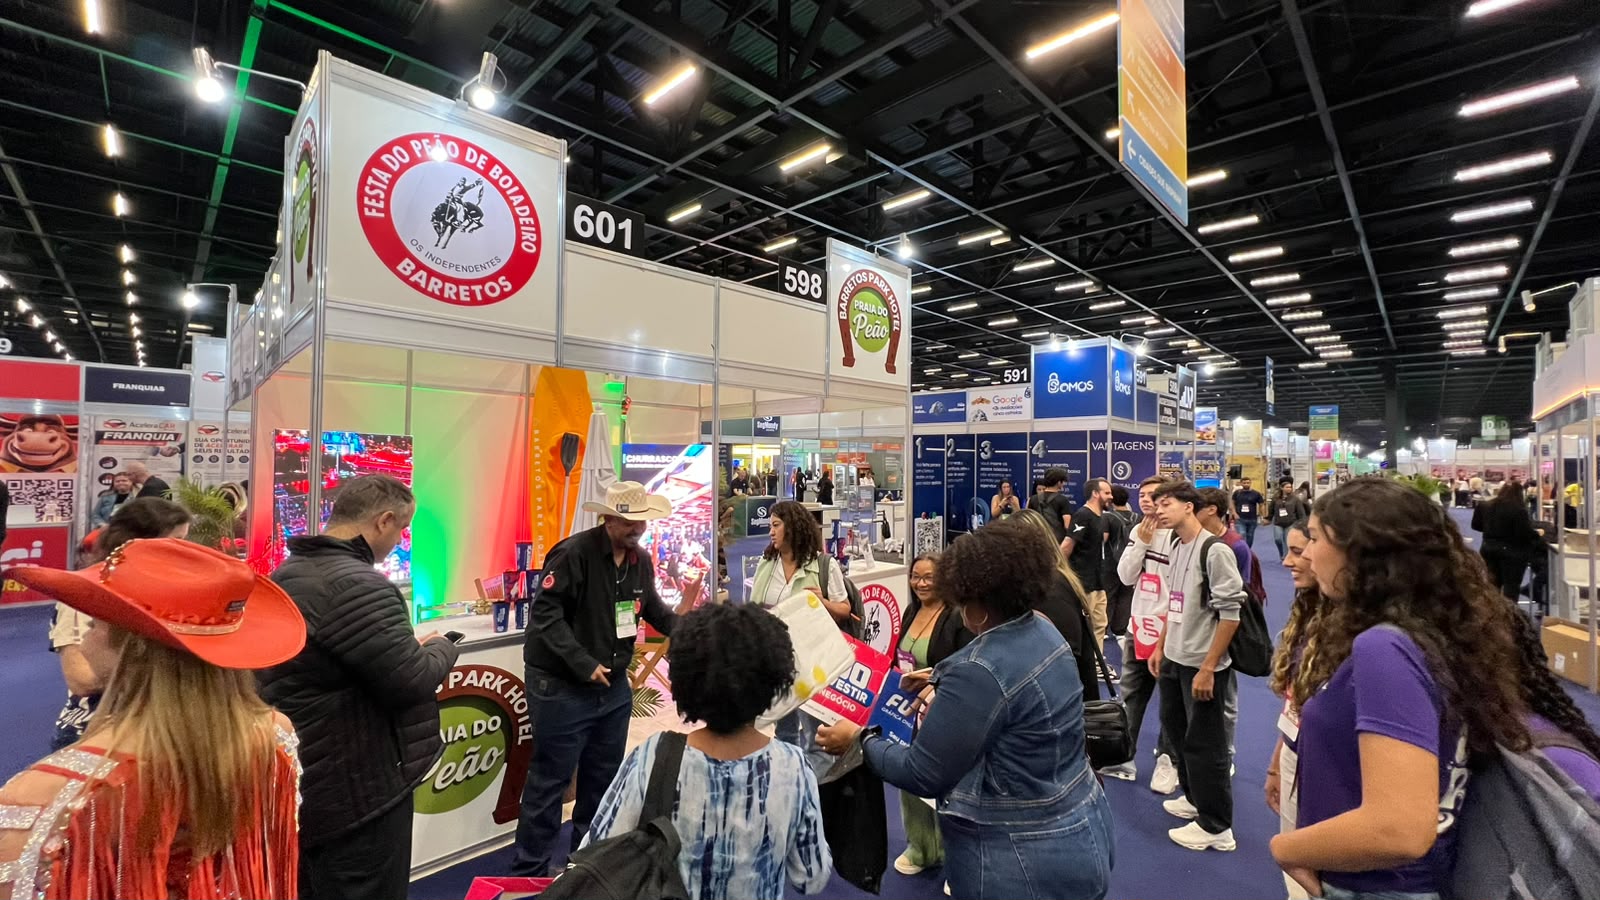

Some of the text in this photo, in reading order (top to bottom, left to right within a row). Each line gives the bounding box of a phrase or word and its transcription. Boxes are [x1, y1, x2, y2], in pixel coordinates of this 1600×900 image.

[364, 168, 392, 218] FESTA
[381, 146, 410, 173] DO
[465, 146, 489, 170] DE
[489, 164, 537, 254] BOIADEIRO
[573, 204, 632, 249] 601
[410, 238, 502, 273] OS INDEPENDENTES
[396, 258, 513, 302] BARRETOS
[784, 266, 822, 299] 598
[839, 272, 900, 332] BARRETOS PARK HOTEL
[854, 300, 888, 317] PRAIA DO
[853, 313, 889, 338] Peão
[112, 382, 165, 392] FRANQUIAS
[1003, 367, 1028, 383] 591
[992, 394, 1023, 405] Google
[103, 431, 176, 441] FRANQUIA
[915, 436, 923, 460] 1
[947, 438, 956, 458] 2
[980, 440, 992, 460] 3
[1031, 440, 1046, 458] 4
[871, 586, 880, 598] DE
[880, 589, 900, 634] BOIADEIRO
[449, 670, 510, 694] PARK
[822, 689, 856, 712] NEGÓCIO
[473, 715, 502, 737] DO
[421, 744, 505, 790] eão
